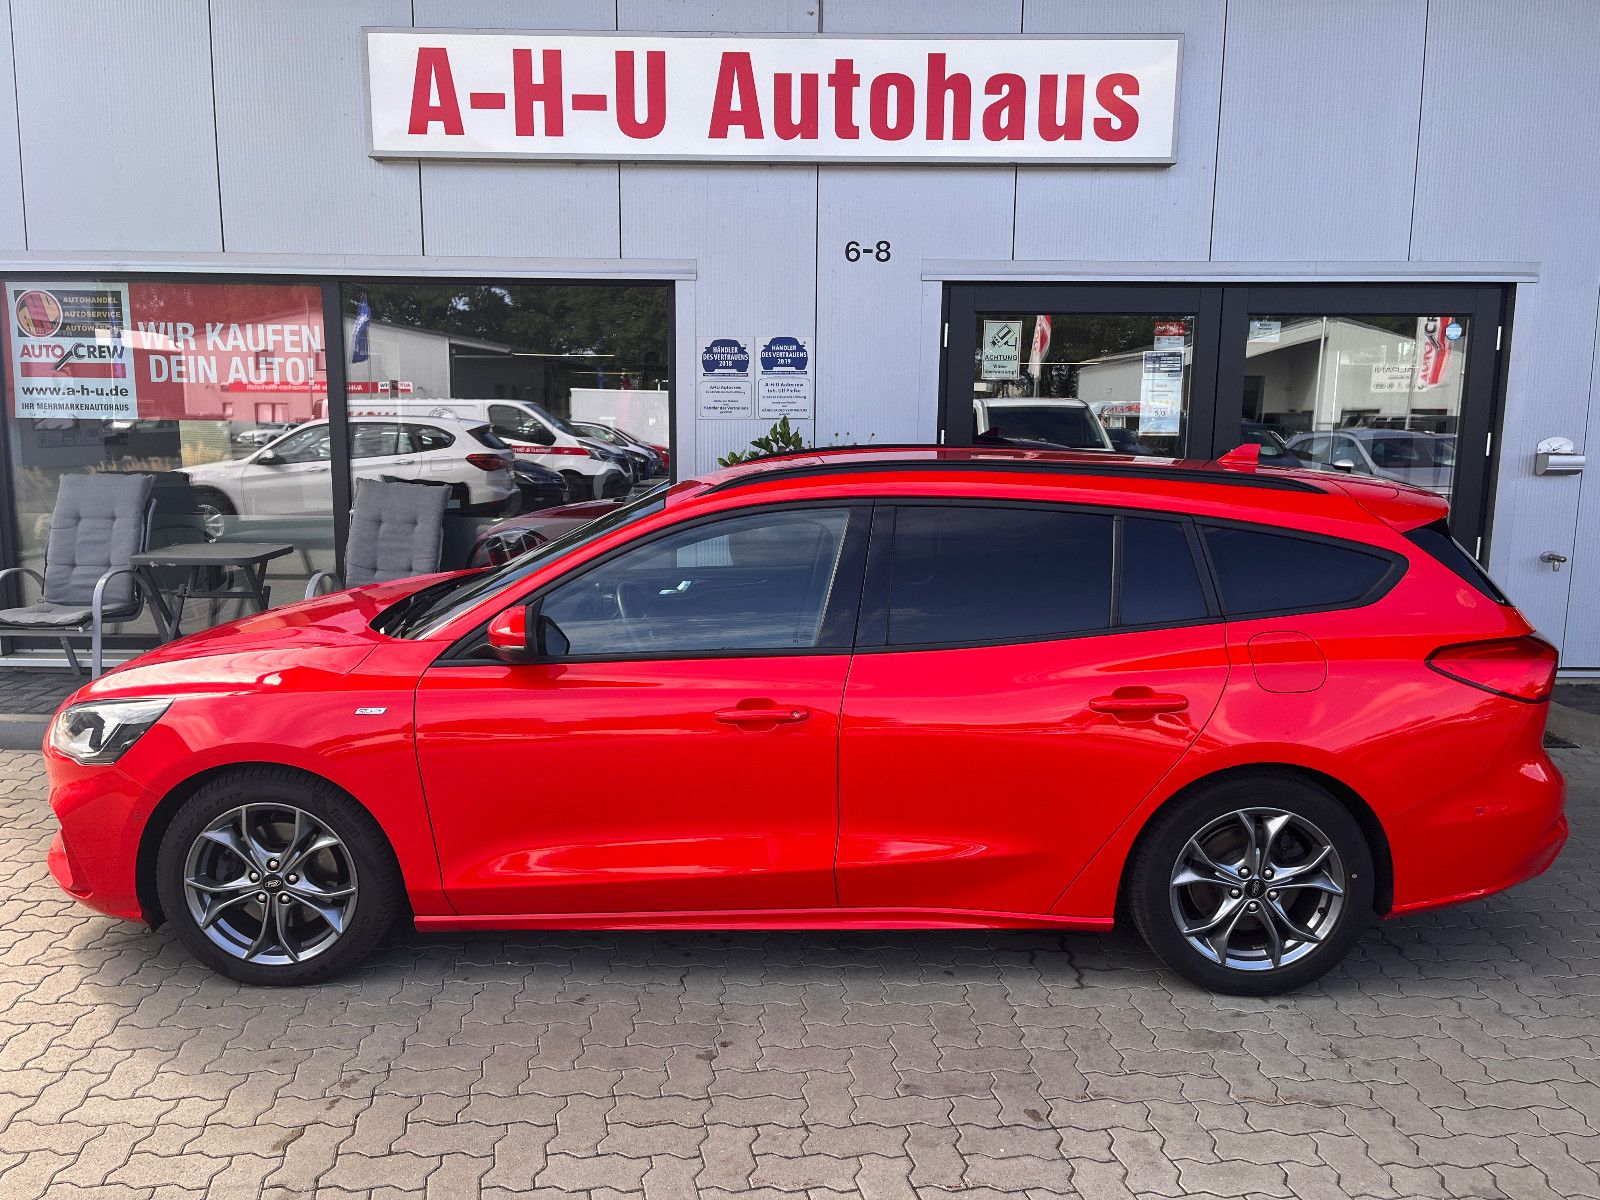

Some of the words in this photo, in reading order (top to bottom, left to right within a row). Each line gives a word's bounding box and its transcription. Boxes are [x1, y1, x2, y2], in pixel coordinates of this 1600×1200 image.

[408, 47, 667, 140] A-H-U
[708, 51, 1140, 142] Autohaus
[845, 240, 891, 262] 6-8
[63, 295, 119, 304] AUTOHANDEL
[64, 311, 122, 319] AUTOSERVICE
[137, 321, 197, 351] WIR
[205, 323, 322, 354] KAUFEN
[20, 344, 65, 359] AUTO
[73, 343, 125, 360] CREW
[149, 354, 219, 385] DEIN
[228, 356, 316, 386] AUTO!
[21, 384, 129, 397] www.a-h-u.de
[37, 403, 129, 411] MEHRMARKENAUTOHAUS
